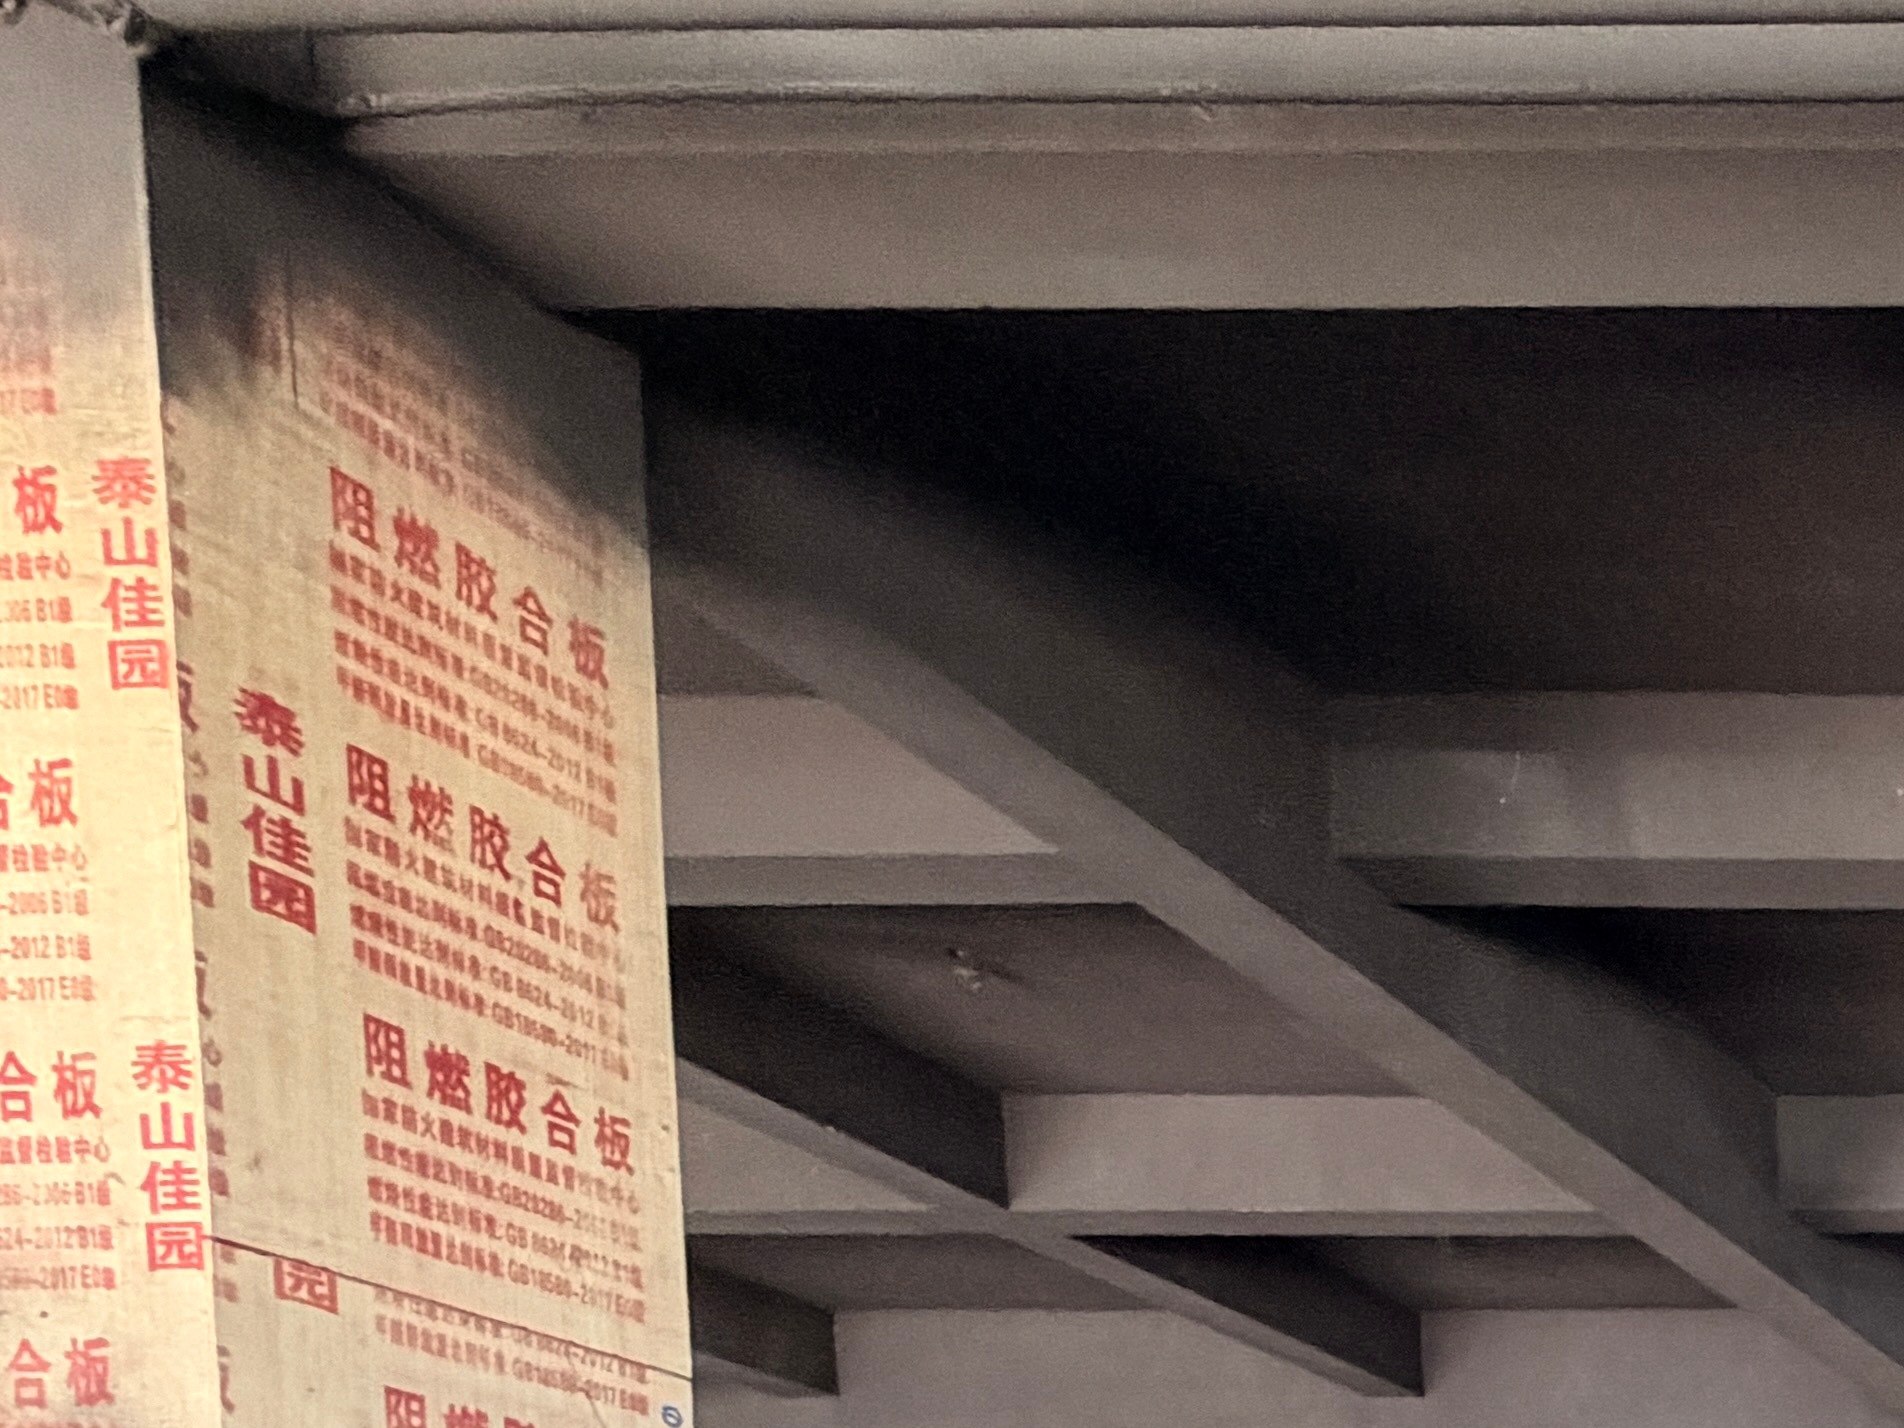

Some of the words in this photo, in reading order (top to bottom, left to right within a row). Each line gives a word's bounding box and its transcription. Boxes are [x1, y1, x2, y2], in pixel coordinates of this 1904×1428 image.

[13, 464, 63, 534] 板
[92, 457, 169, 690] 泰山佳园
[329, 466, 608, 690] 阻燃胶合板
[234, 686, 317, 934] 泰山佳园
[346, 744, 619, 933] 阻燃胶合板
[0, 1051, 102, 1122] 合板
[131, 1039, 205, 1272] 泰山佳园
[363, 1012, 634, 1176] 阻燃胶合板
[8, 1338, 116, 1409] 合板
